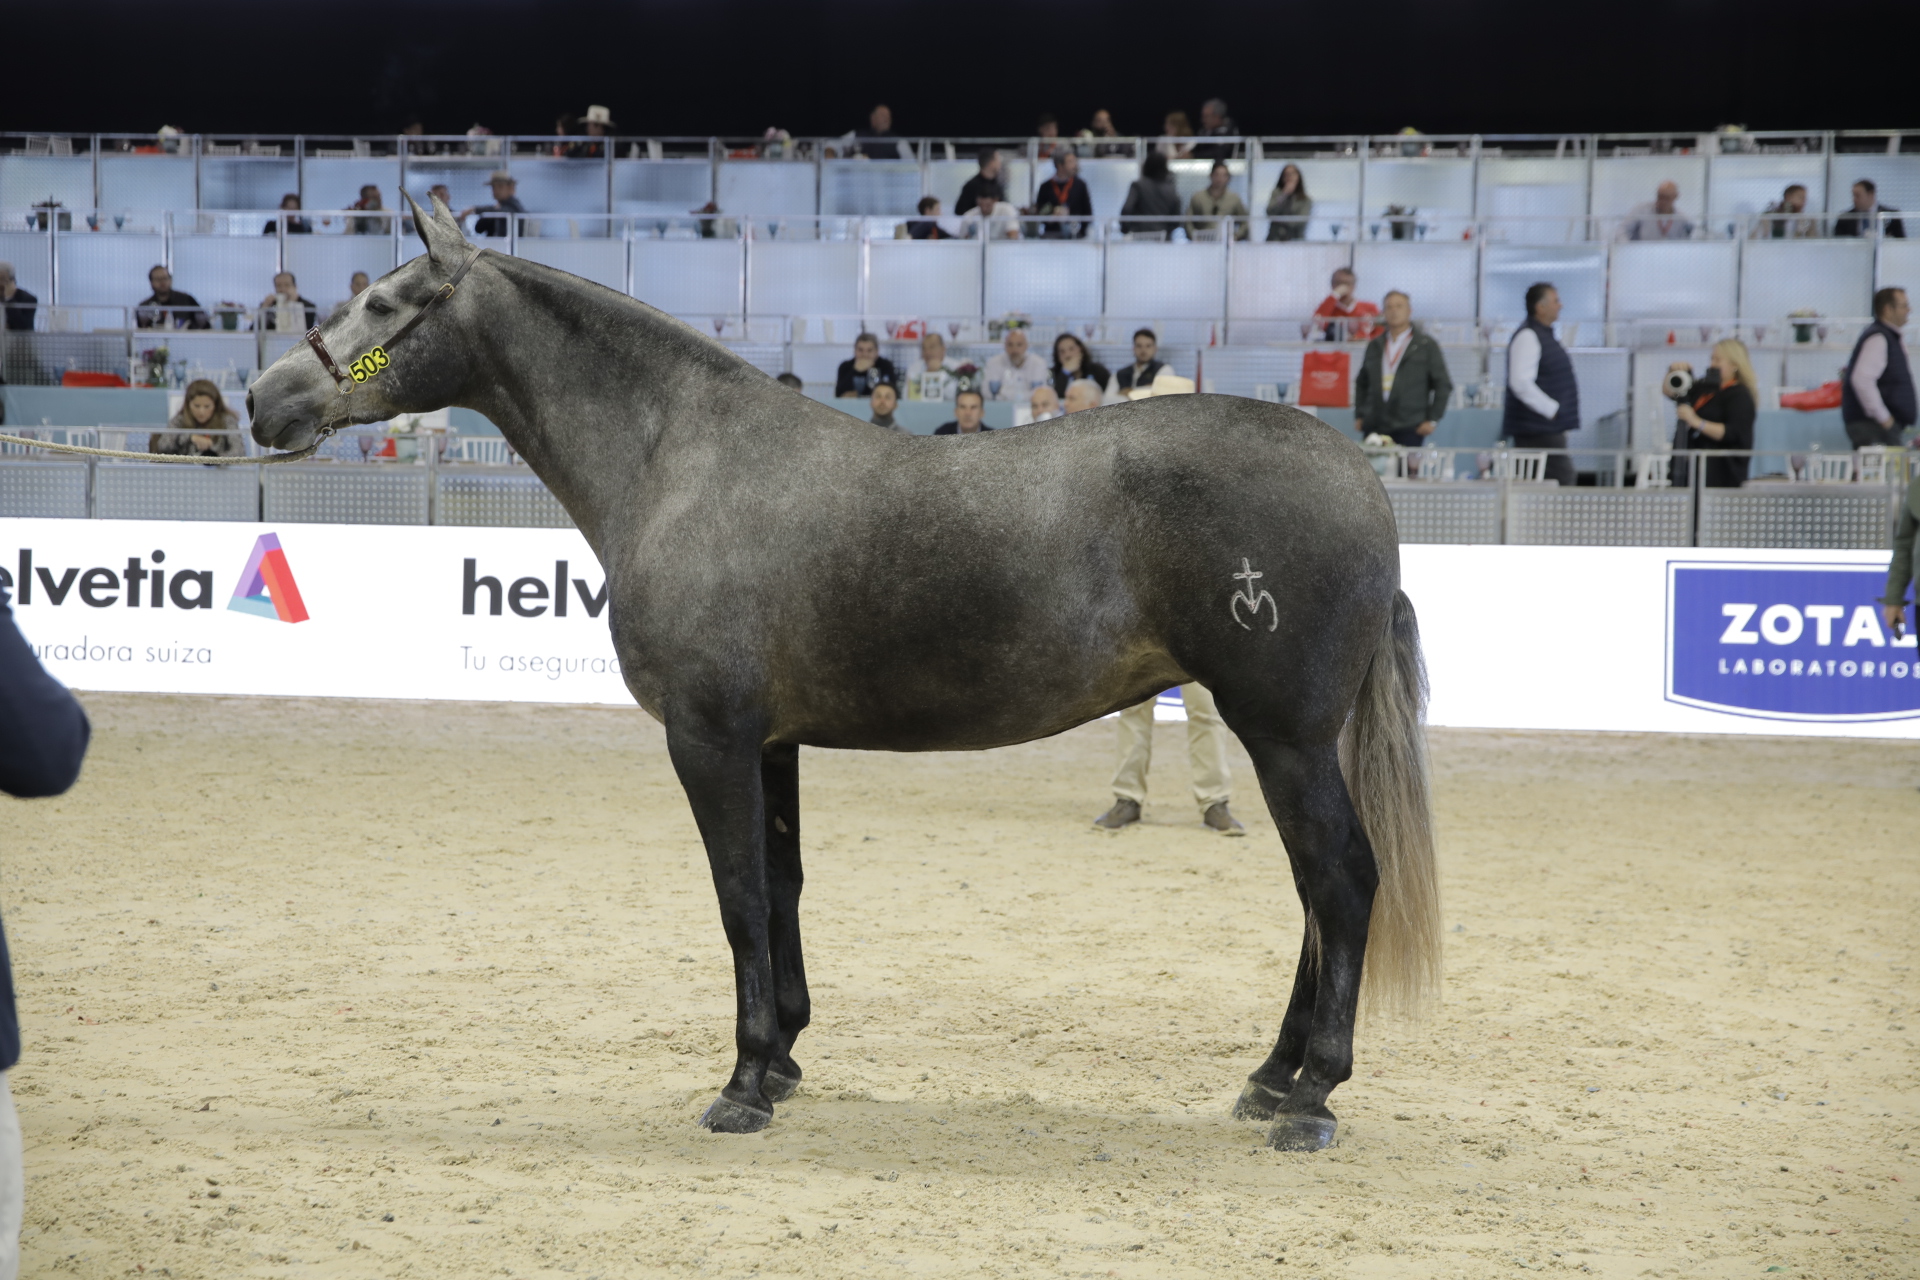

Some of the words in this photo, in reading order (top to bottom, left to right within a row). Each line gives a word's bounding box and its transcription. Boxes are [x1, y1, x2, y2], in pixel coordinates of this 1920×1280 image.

[349, 347, 389, 382] 503
[0, 548, 212, 610] lvetia
[462, 557, 608, 618] helv
[30, 635, 132, 663] uradora
[145, 640, 212, 664] suiza
[460, 645, 486, 672] Tu
[500, 652, 620, 682] asegura
